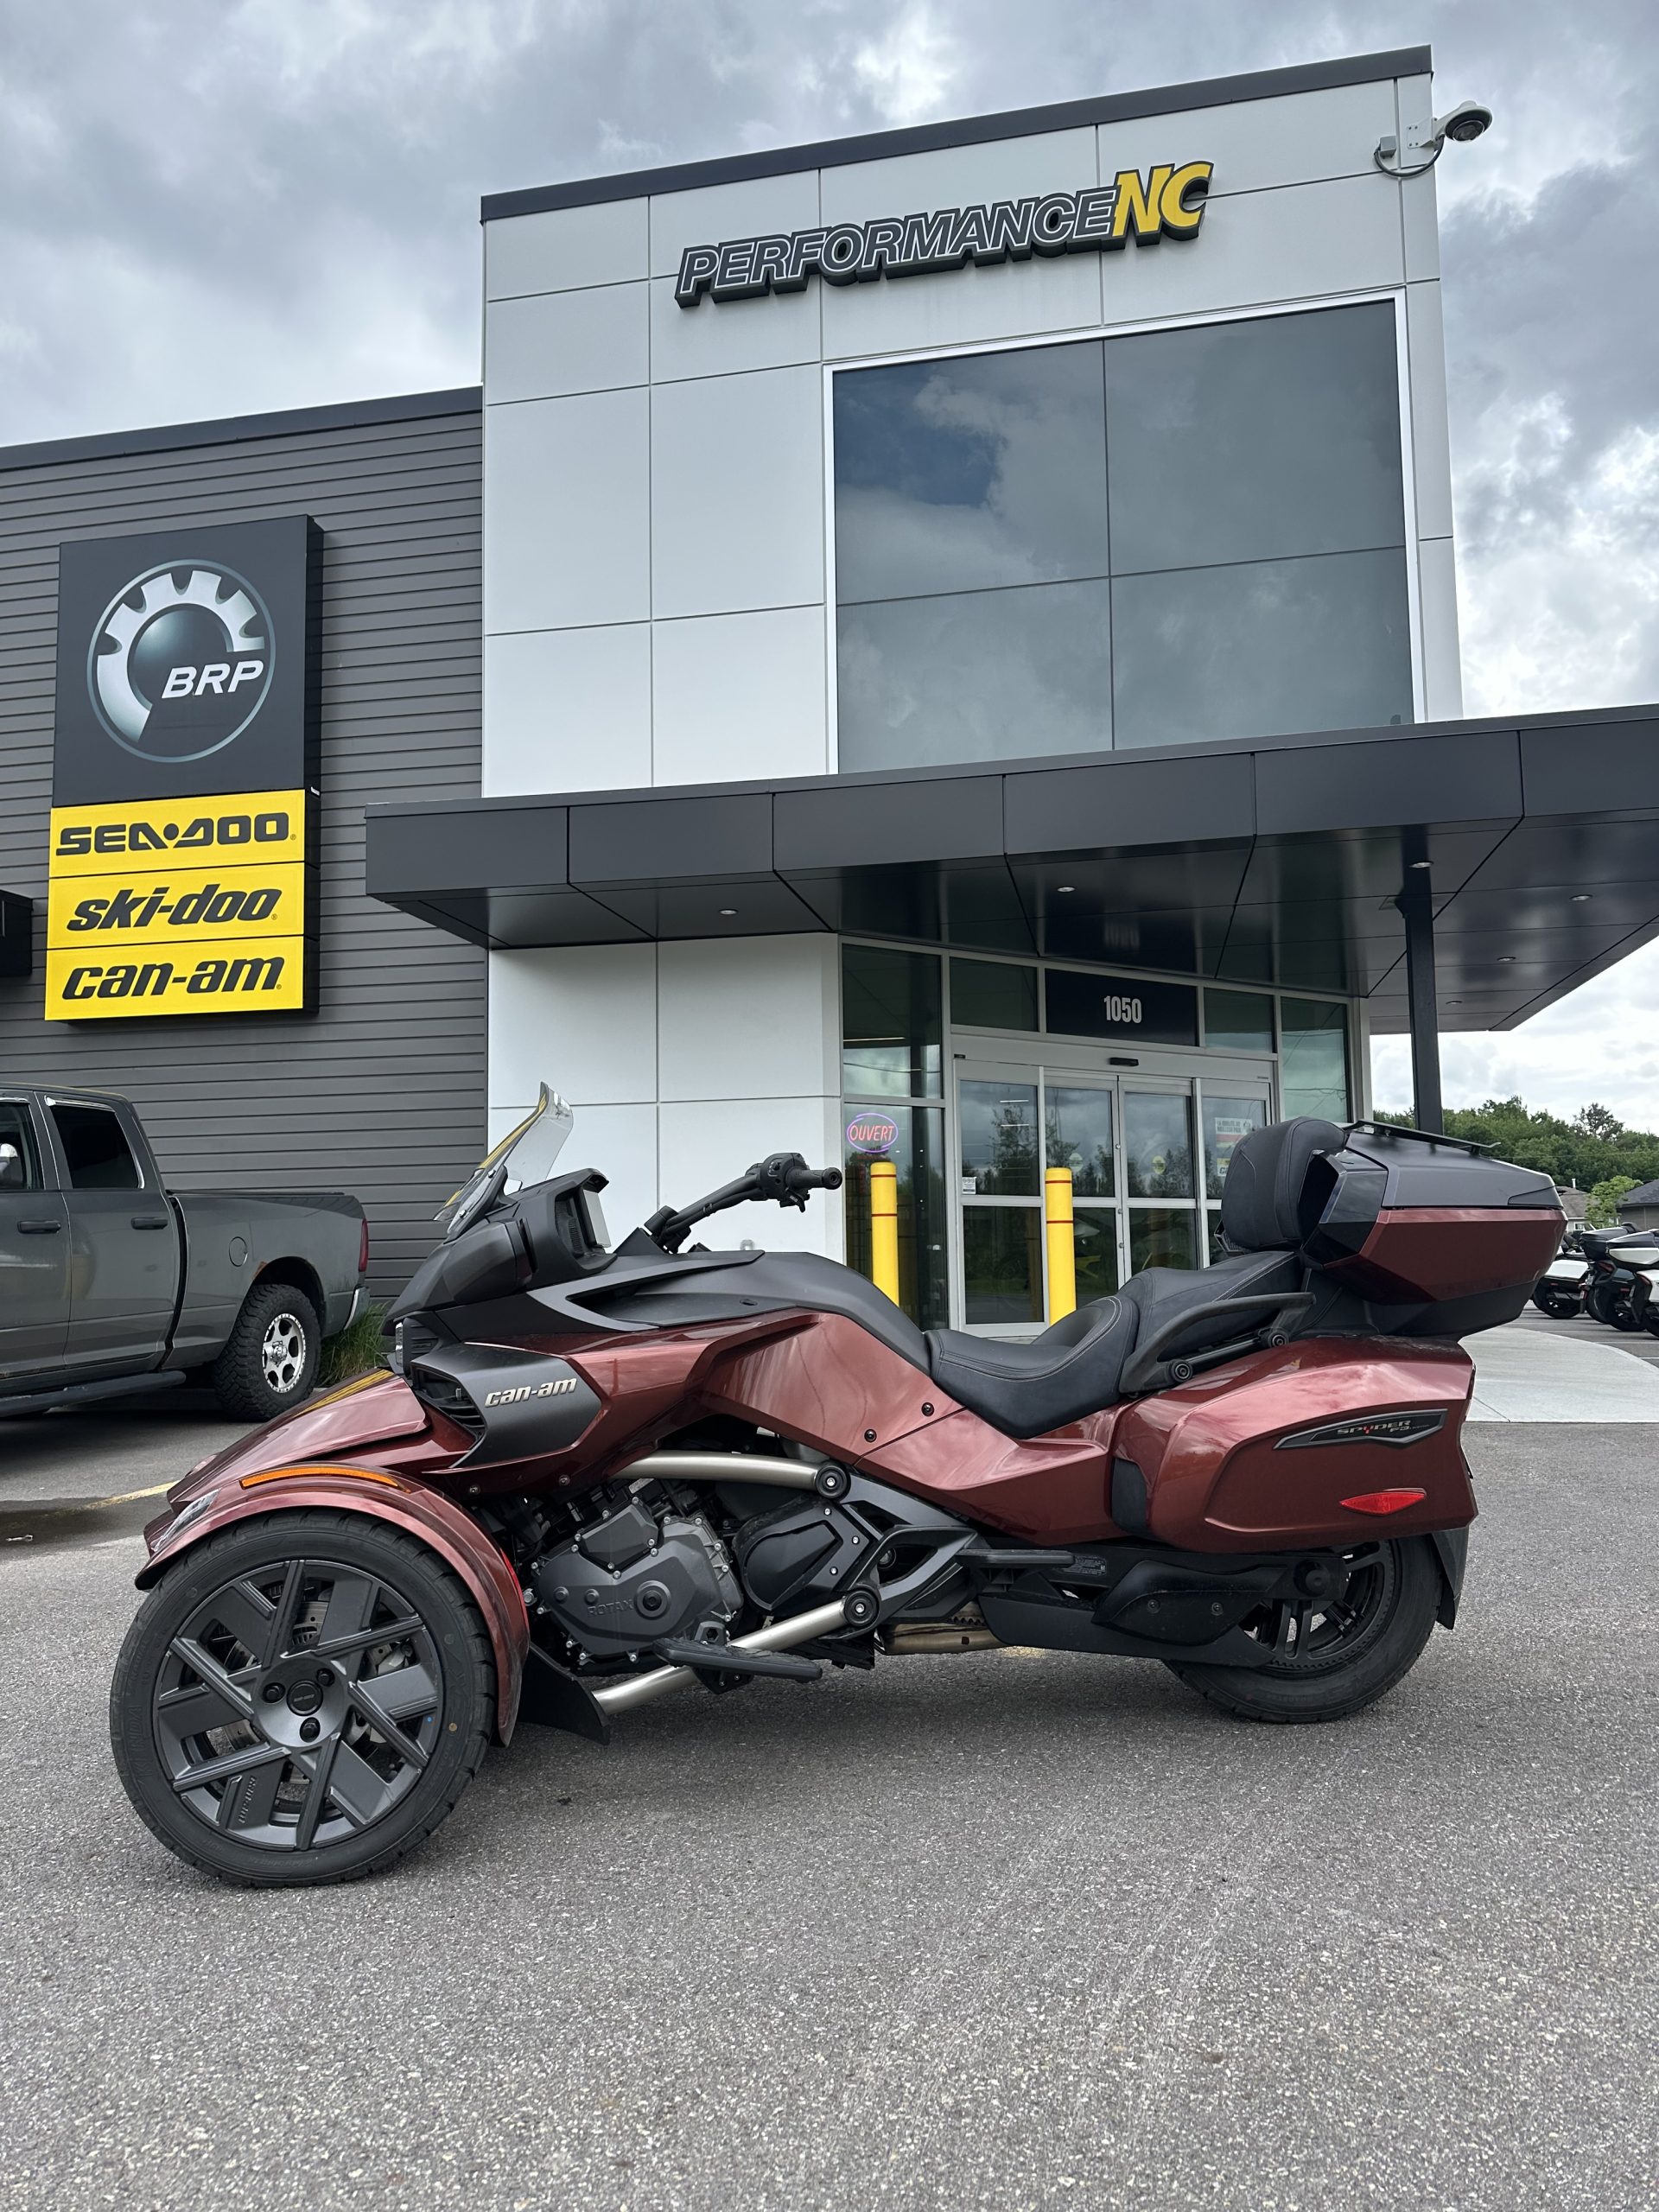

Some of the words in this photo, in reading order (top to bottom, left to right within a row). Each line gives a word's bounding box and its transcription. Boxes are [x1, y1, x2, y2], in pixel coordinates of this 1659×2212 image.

[162, 659, 264, 699] BRP
[67, 883, 283, 932] ski-doo
[62, 955, 285, 1001] can-am
[1103, 995, 1143, 1025] 1050
[849, 1124, 895, 1141] OUVERT
[484, 1377, 577, 1408] can-am
[1338, 1421, 1411, 1434] SPYDER
[587, 1599, 634, 1618] ROTAX
